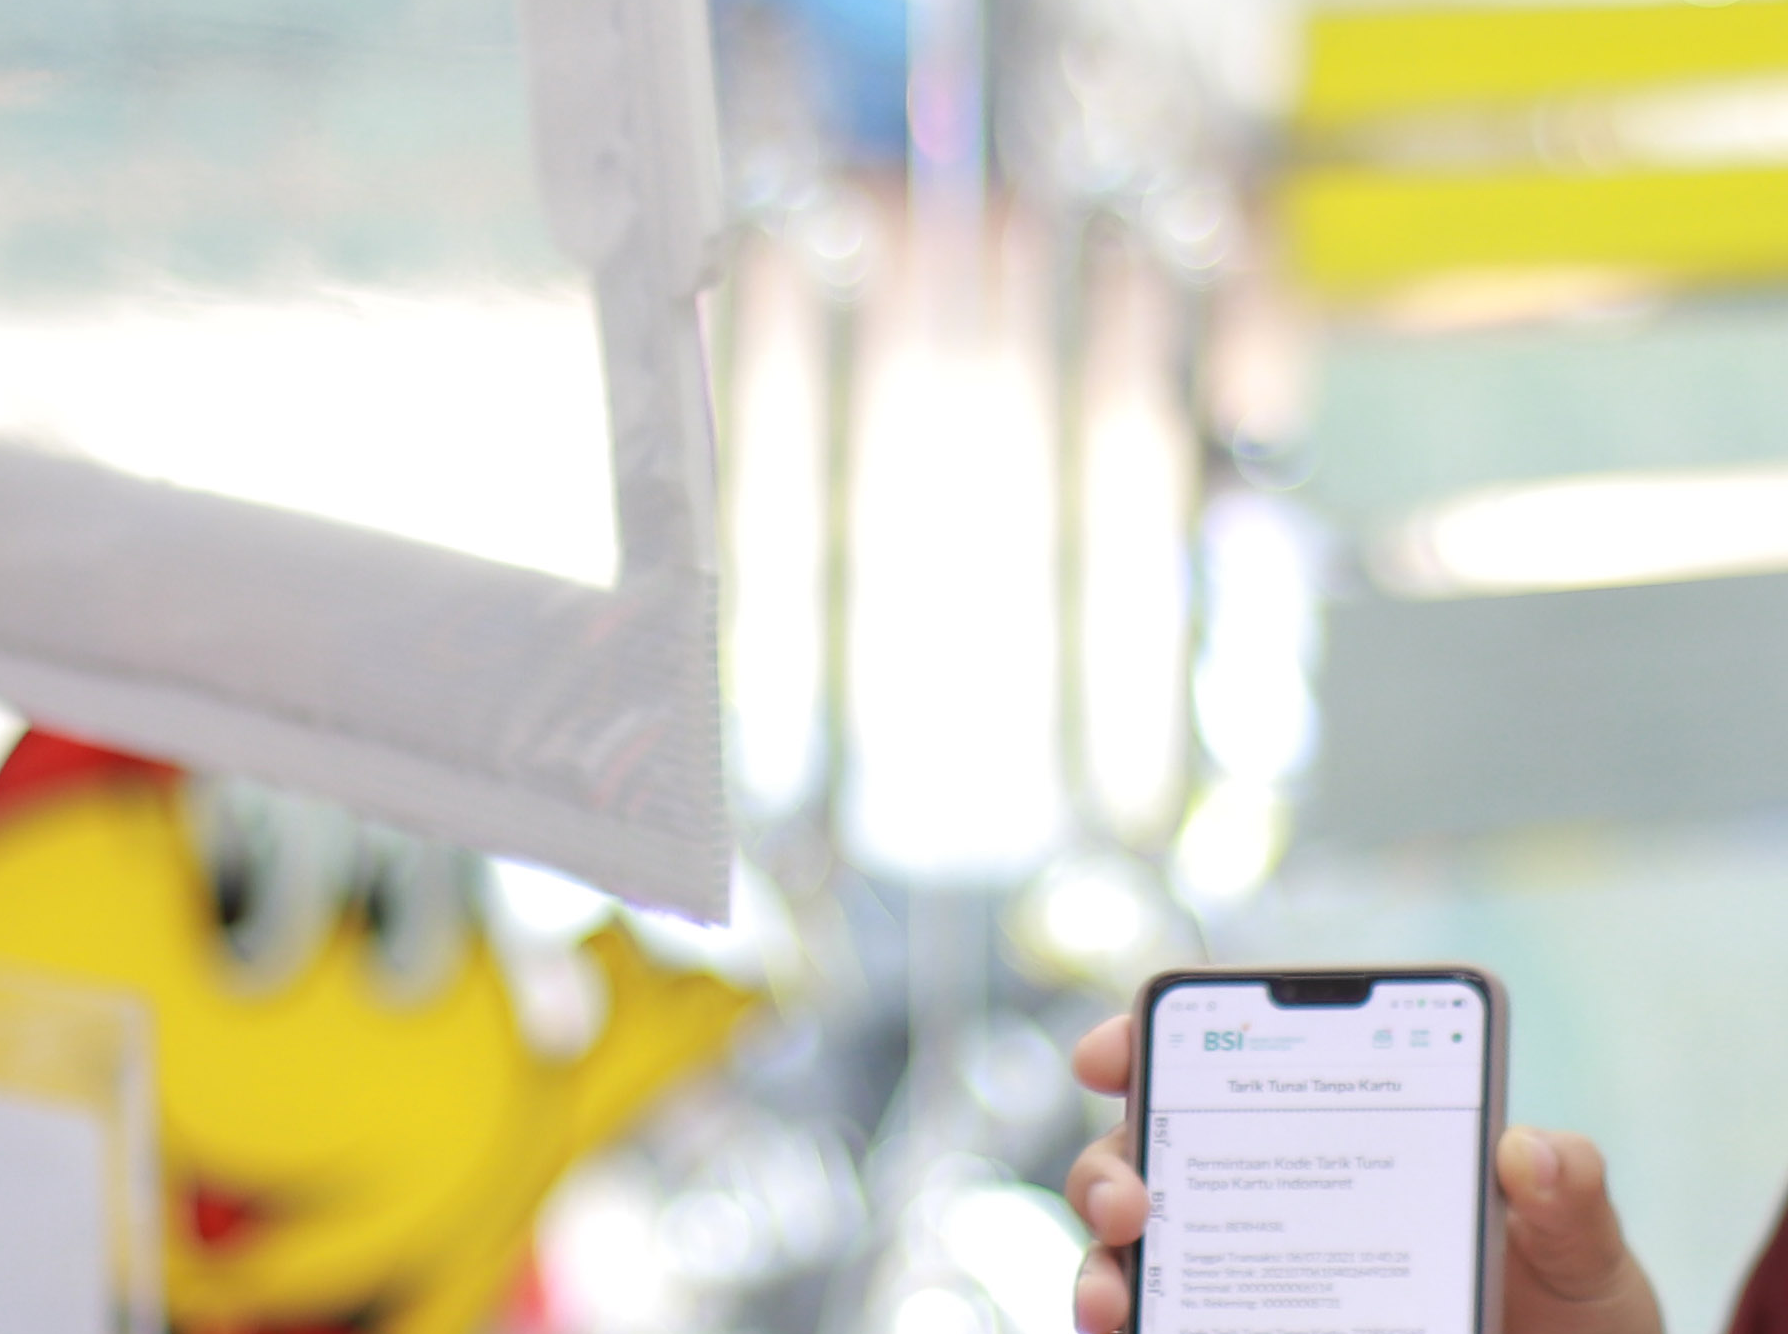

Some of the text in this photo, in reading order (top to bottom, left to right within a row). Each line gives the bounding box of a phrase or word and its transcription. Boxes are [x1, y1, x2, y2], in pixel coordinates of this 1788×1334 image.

[1203, 1030, 1244, 1051] BSI
[1228, 1078, 1402, 1095] Tarik Tunai Tanpa Kartu
[1186, 1156, 1395, 1171] Permintaan Kode Tarik Tunai
[1186, 1177, 1353, 1192] Tanpa Kartu Indomaret
